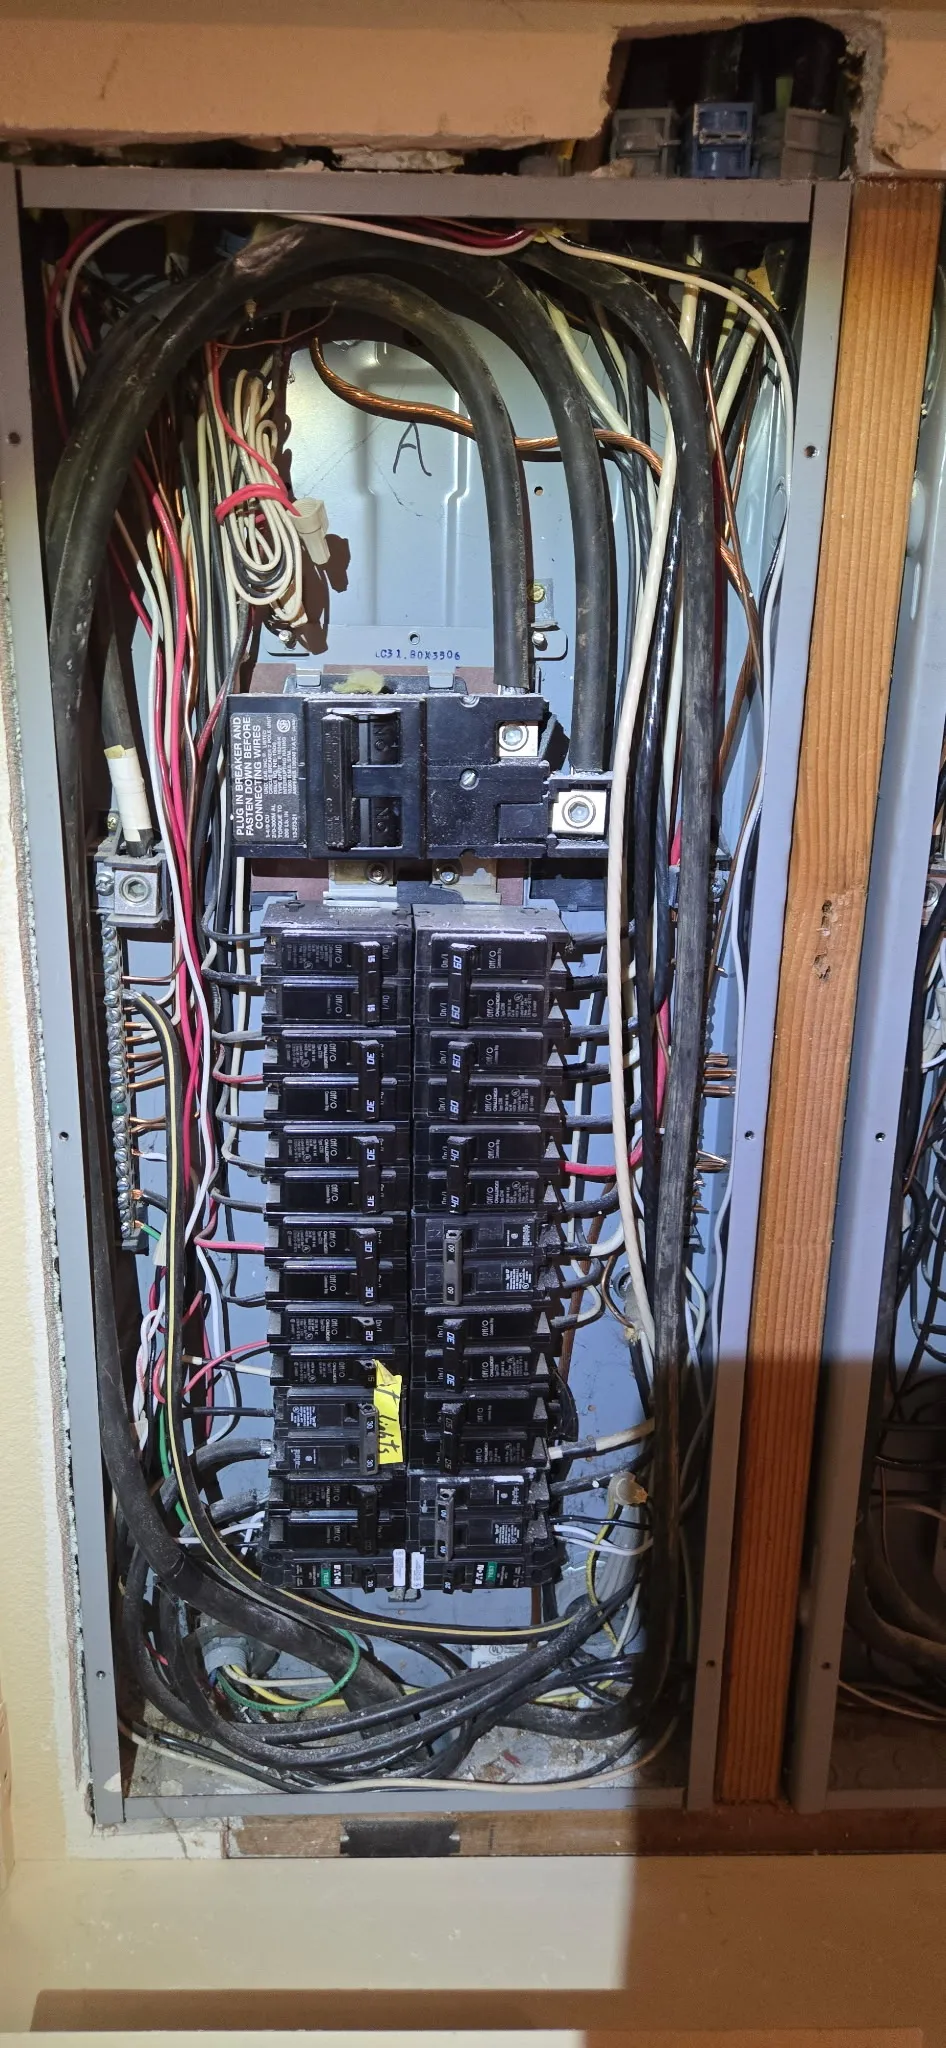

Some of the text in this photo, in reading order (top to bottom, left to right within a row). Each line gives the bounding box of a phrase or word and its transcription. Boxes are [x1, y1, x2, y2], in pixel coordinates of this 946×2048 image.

[393, 421, 432, 477] A
[233, 717, 244, 835] PLUG IN BREAKER AND
[243, 717, 254, 835] FASTEN DOWN BEFORE
[253, 725, 263, 829] CONNECTING WIRES
[278, 805, 282, 813] TO
[368, 955, 376, 963] 15
[453, 955, 462, 970] 60
[367, 1004, 375, 1012] 15
[451, 1004, 460, 1019] 60
[366, 1052, 375, 1065] 30
[452, 1054, 461, 1068] 60
[366, 1100, 375, 1112] 30
[450, 1100, 459, 1114] 60
[367, 1149, 375, 1160] 30
[451, 1149, 459, 1161] 40
[367, 1195, 374, 1206] 30
[451, 1195, 459, 1207] 40
[365, 1241, 372, 1252] 30
[448, 1244, 455, 1252] 60
[365, 1286, 373, 1297] 30
[365, 1330, 374, 1341] 20
[447, 1331, 455, 1344] 30
[447, 1373, 455, 1386] 30
[366, 1421, 374, 1429] 30
[366, 1460, 374, 1468] 30
